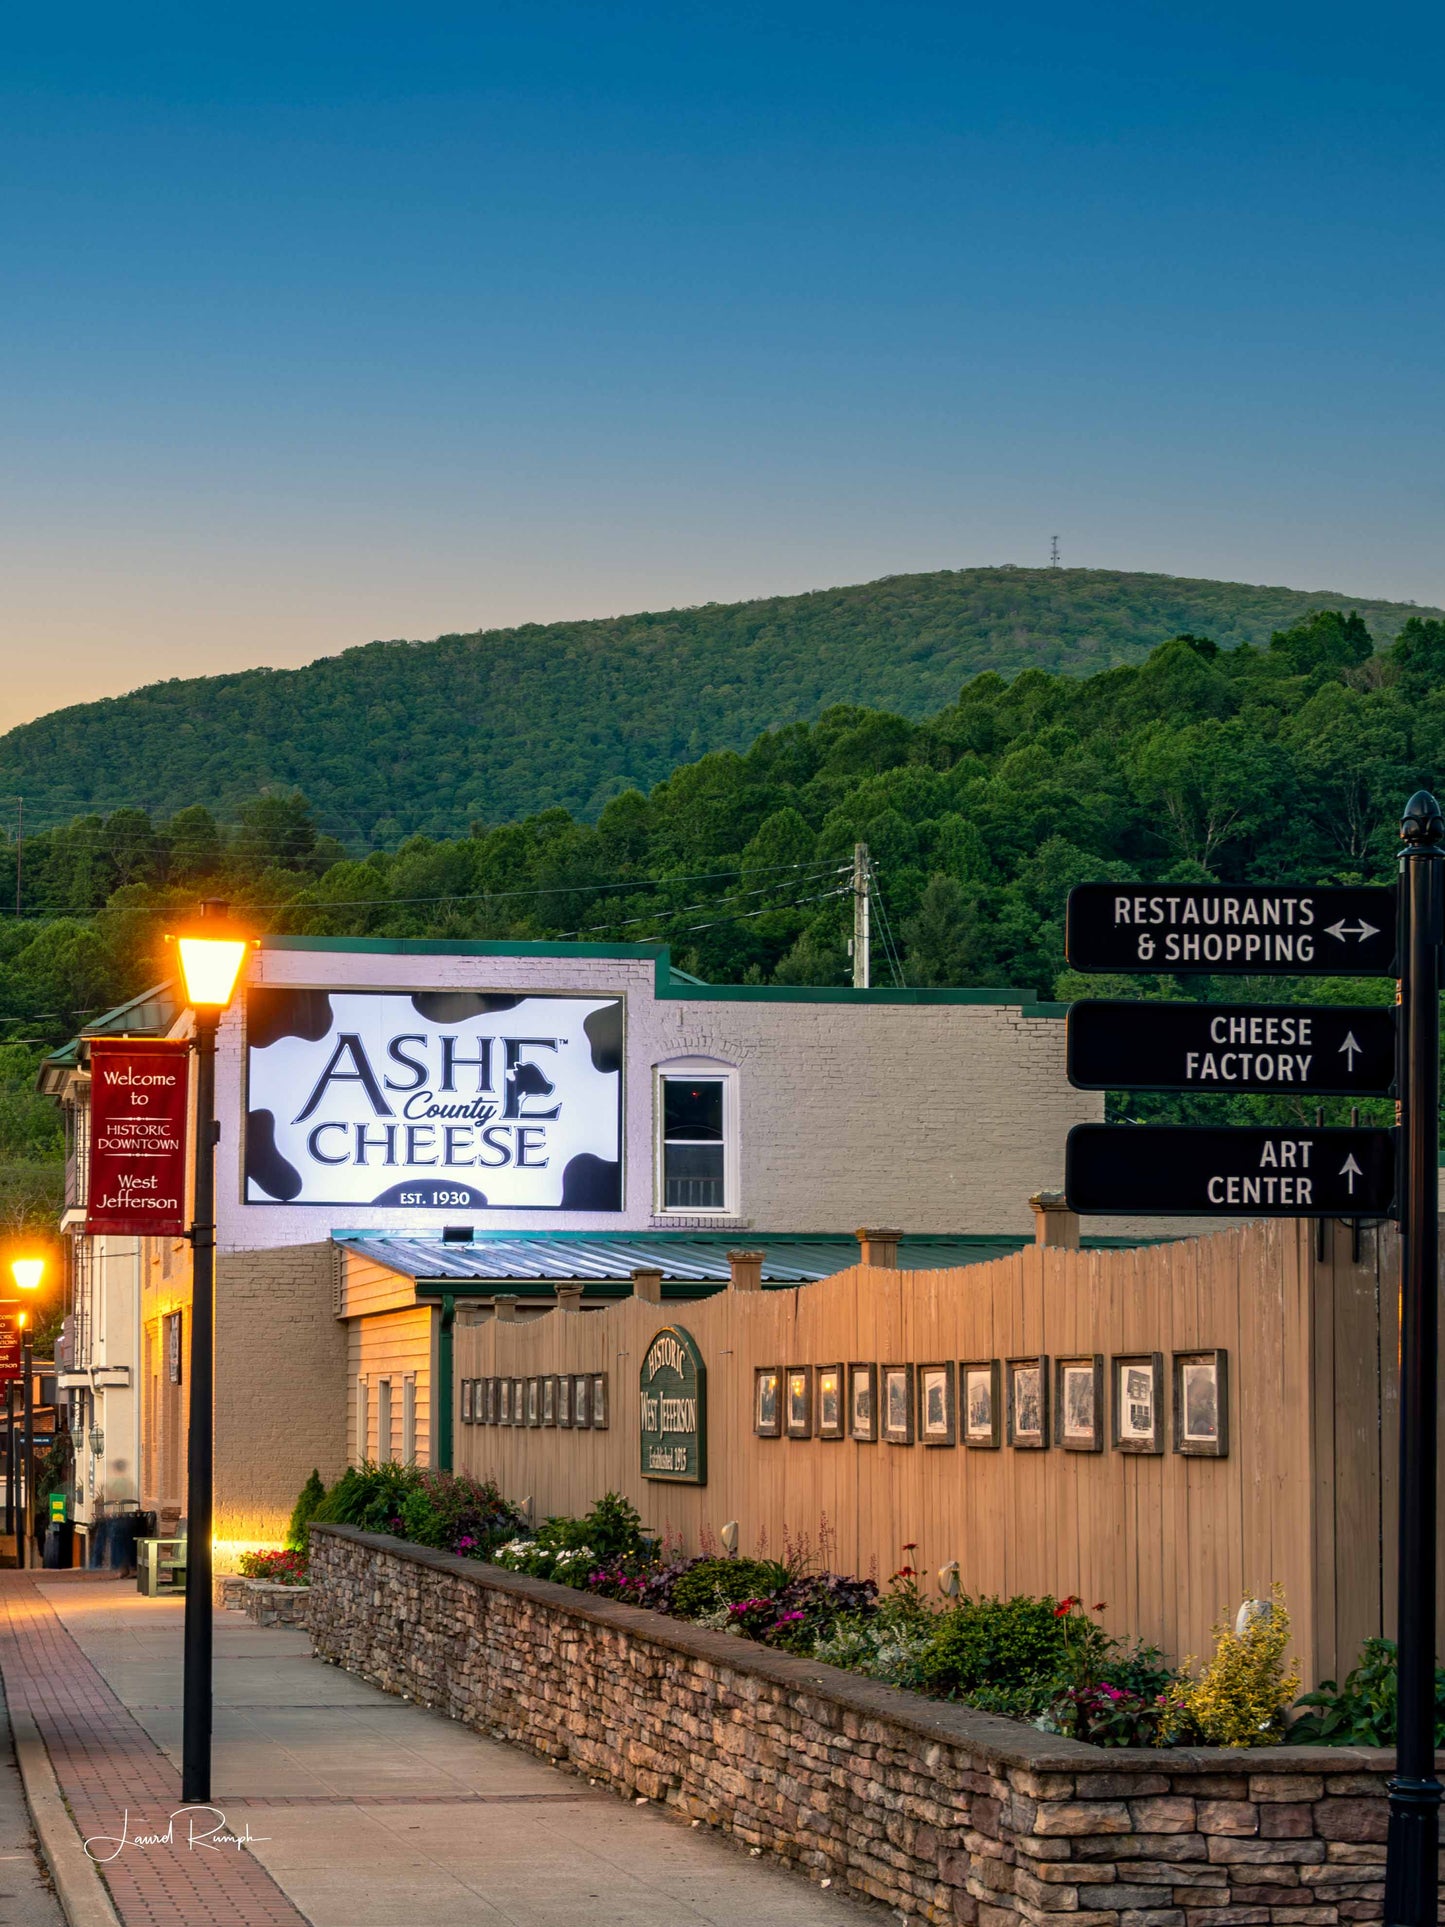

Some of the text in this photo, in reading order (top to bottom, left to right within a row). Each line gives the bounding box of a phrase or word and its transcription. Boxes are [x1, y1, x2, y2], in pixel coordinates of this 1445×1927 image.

[1114, 897, 1315, 925] RESTAURANTS
[1137, 933, 1315, 962] & SHOPPING
[1210, 1016, 1313, 1045] CHEESE
[104, 1066, 176, 1086] Welcome
[291, 1032, 563, 1124] ASHE
[1186, 1052, 1313, 1081] FACTORY
[131, 1091, 149, 1106] to
[403, 1091, 499, 1127] County
[98, 1138, 179, 1150] DOWNTOWN
[107, 1124, 171, 1136] HISTORIC
[306, 1121, 550, 1168] CHEESE
[1259, 1140, 1313, 1168] ART
[118, 1174, 158, 1189] West
[1207, 1176, 1313, 1204] CENTER
[96, 1188, 178, 1209] Jefferson
[400, 1191, 470, 1205] EST. 1930
[648, 1337, 686, 1381] HISTORIC
